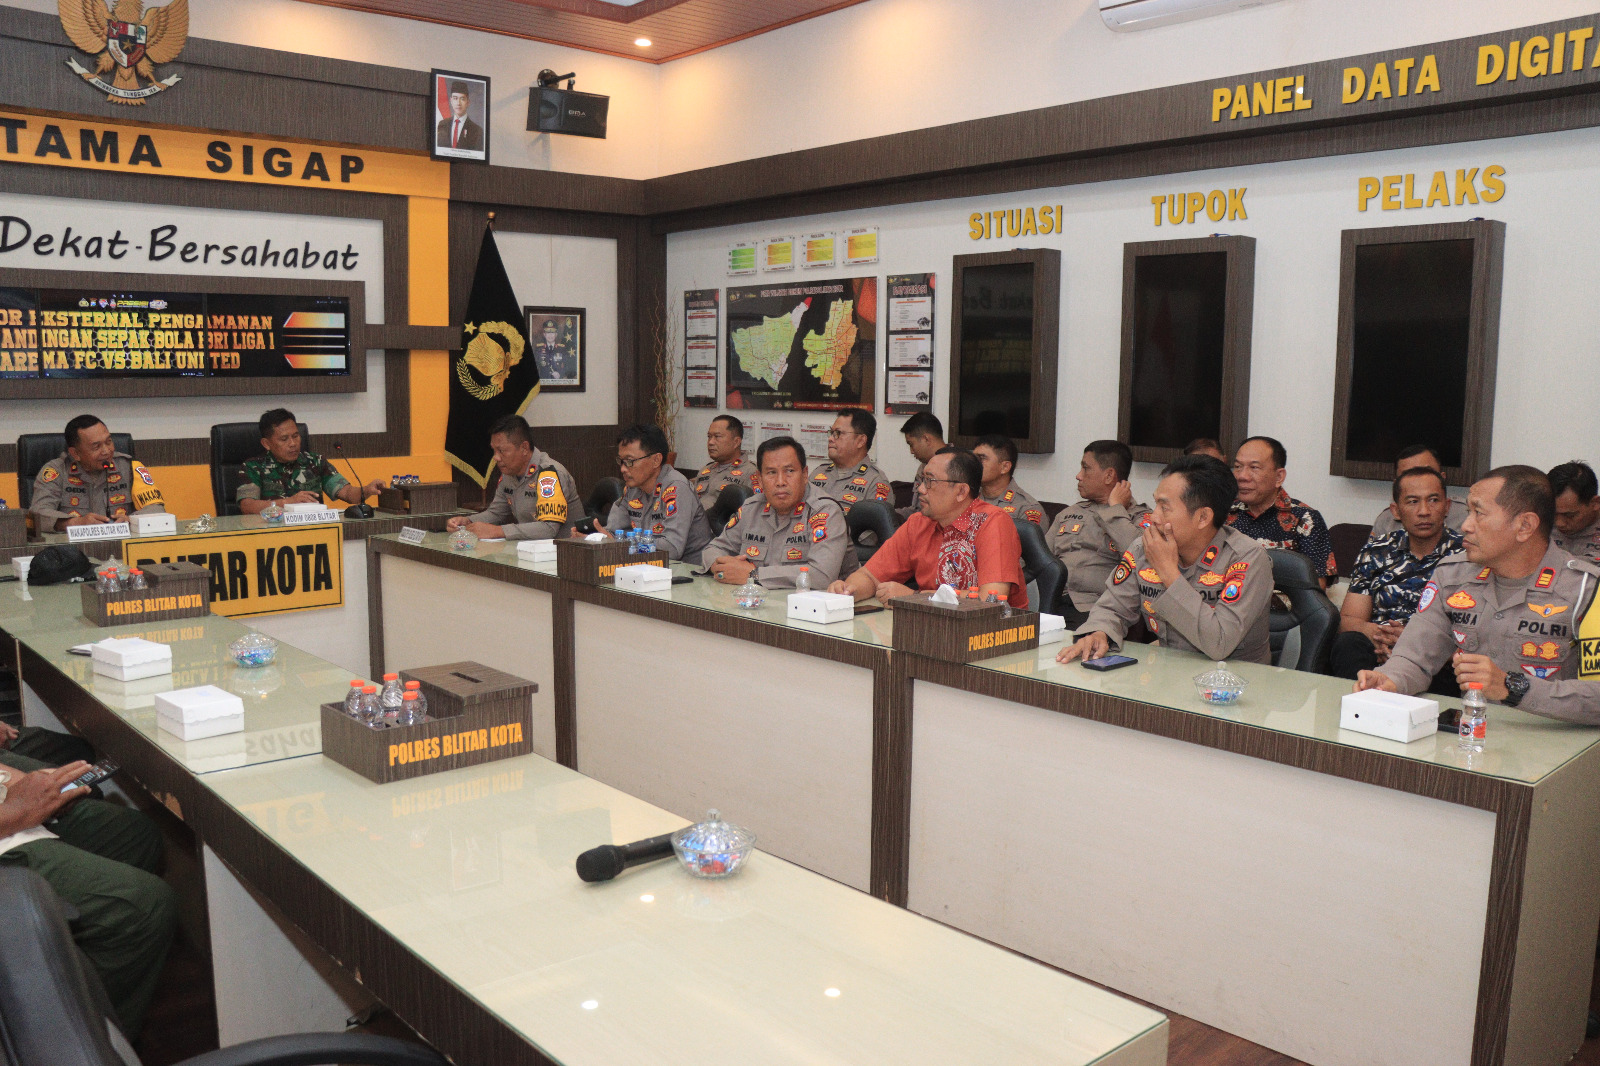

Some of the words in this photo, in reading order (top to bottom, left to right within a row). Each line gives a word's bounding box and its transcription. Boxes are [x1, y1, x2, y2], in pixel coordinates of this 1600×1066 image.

[1211, 76, 1312, 122] PANEL
[1342, 55, 1440, 104] DATA
[0, 118, 162, 168] TAMA
[206, 140, 364, 183] SIGAP
[1358, 165, 1506, 212] PELAKS
[1151, 187, 1247, 226] TUPOK
[968, 205, 1062, 240] SITUASI
[97, 329, 150, 349] SEPAK
[154, 330, 195, 349] BOLA
[232, 331, 266, 350] LIGA
[0, 350, 69, 371] AREMA
[73, 350, 97, 370] FC
[101, 350, 126, 370] VS
[130, 350, 172, 370] BALI
[175, 350, 241, 370] UNITED
[844, 484, 866, 494] POLRI
[317, 511, 337, 521] BLITAR
[69, 525, 100, 538] WAKAPOLRES
[100, 525, 116, 536] BLITAR
[785, 535, 807, 544] POLRI
[256, 543, 334, 598] KOTA
[106, 598, 143, 617] POLRES
[144, 595, 178, 613] BLITAR
[178, 593, 203, 610] KOTA
[968, 631, 995, 652] POLRES
[994, 627, 1018, 647] BLITAR
[1018, 624, 1036, 642] KOTA
[1518, 619, 1568, 637] POLRI
[388, 736, 441, 767] POLRES
[442, 728, 488, 757] BLITAR
[490, 722, 523, 748] KOTA
